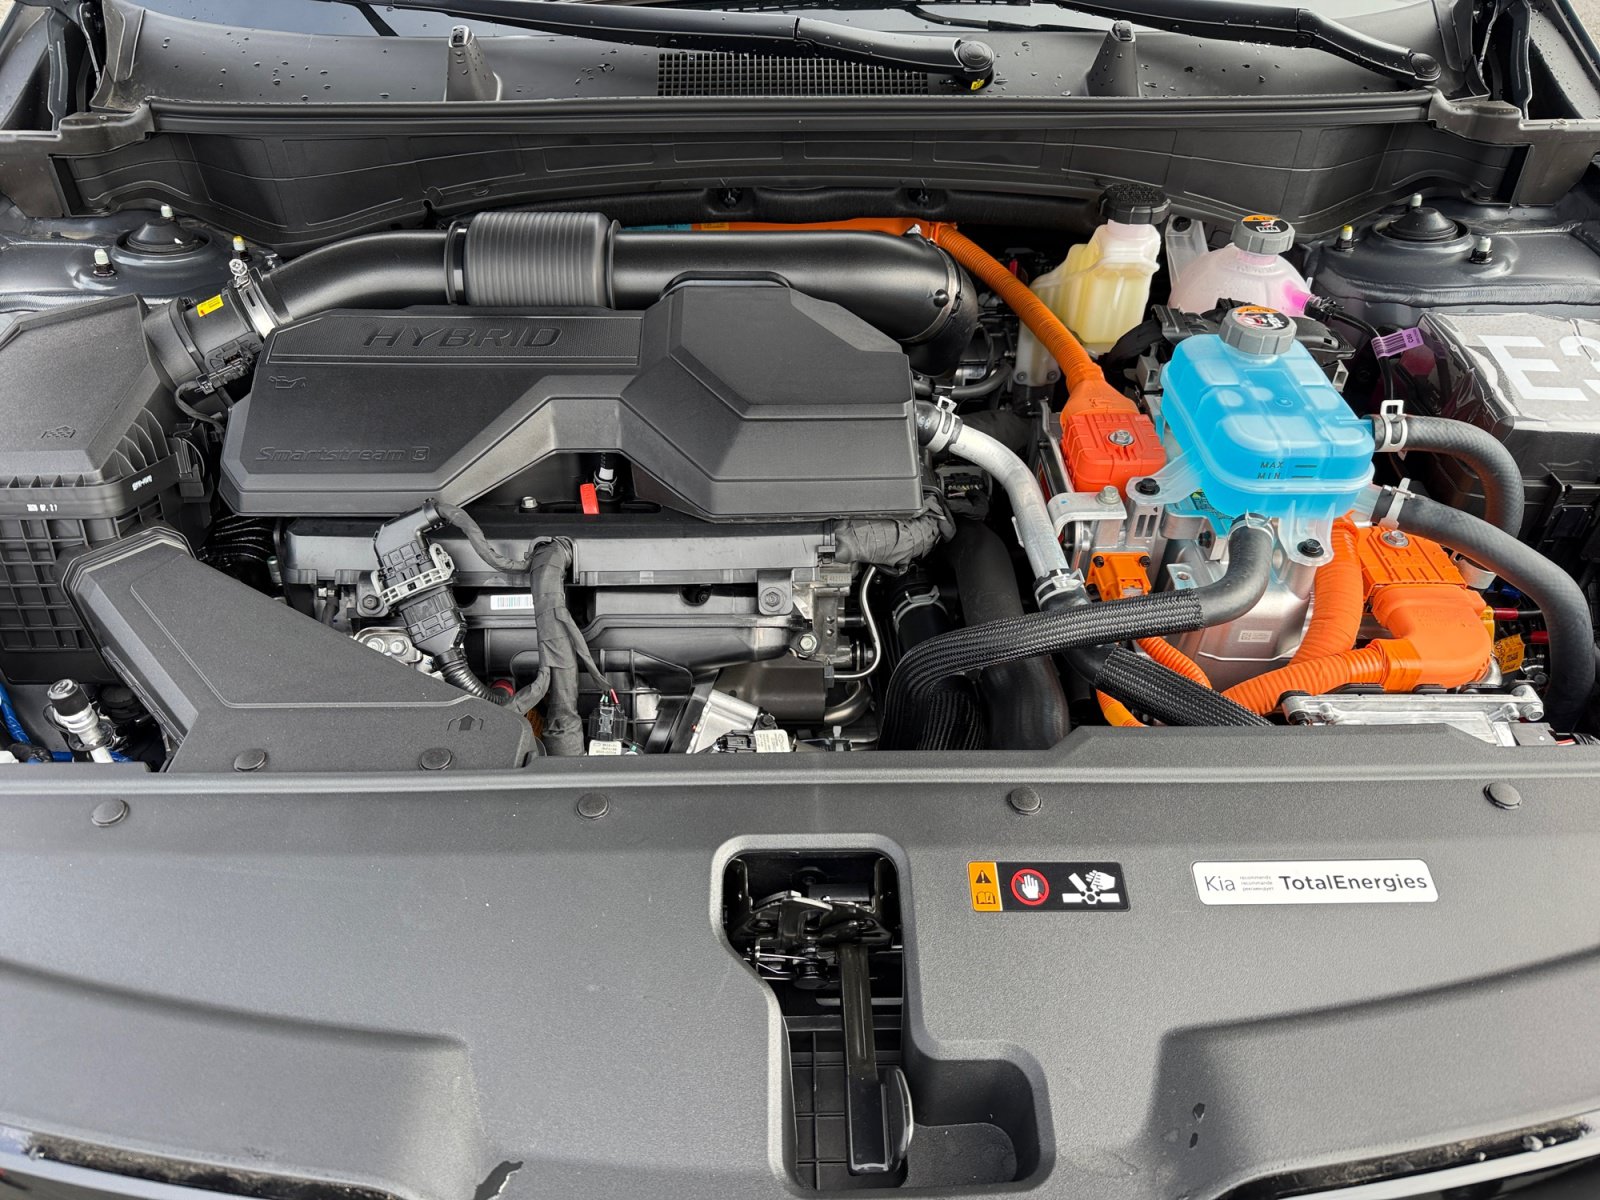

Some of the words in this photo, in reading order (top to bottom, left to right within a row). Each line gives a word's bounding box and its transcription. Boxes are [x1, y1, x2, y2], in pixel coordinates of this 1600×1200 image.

[363, 327, 563, 348] HYBRID
[255, 446, 405, 461] Smartstream
[1260, 461, 1284, 469] MAX
[1257, 472, 1280, 480] MIN
[1204, 875, 1236, 892] Kia
[1278, 874, 1428, 893] TotalEnergies
